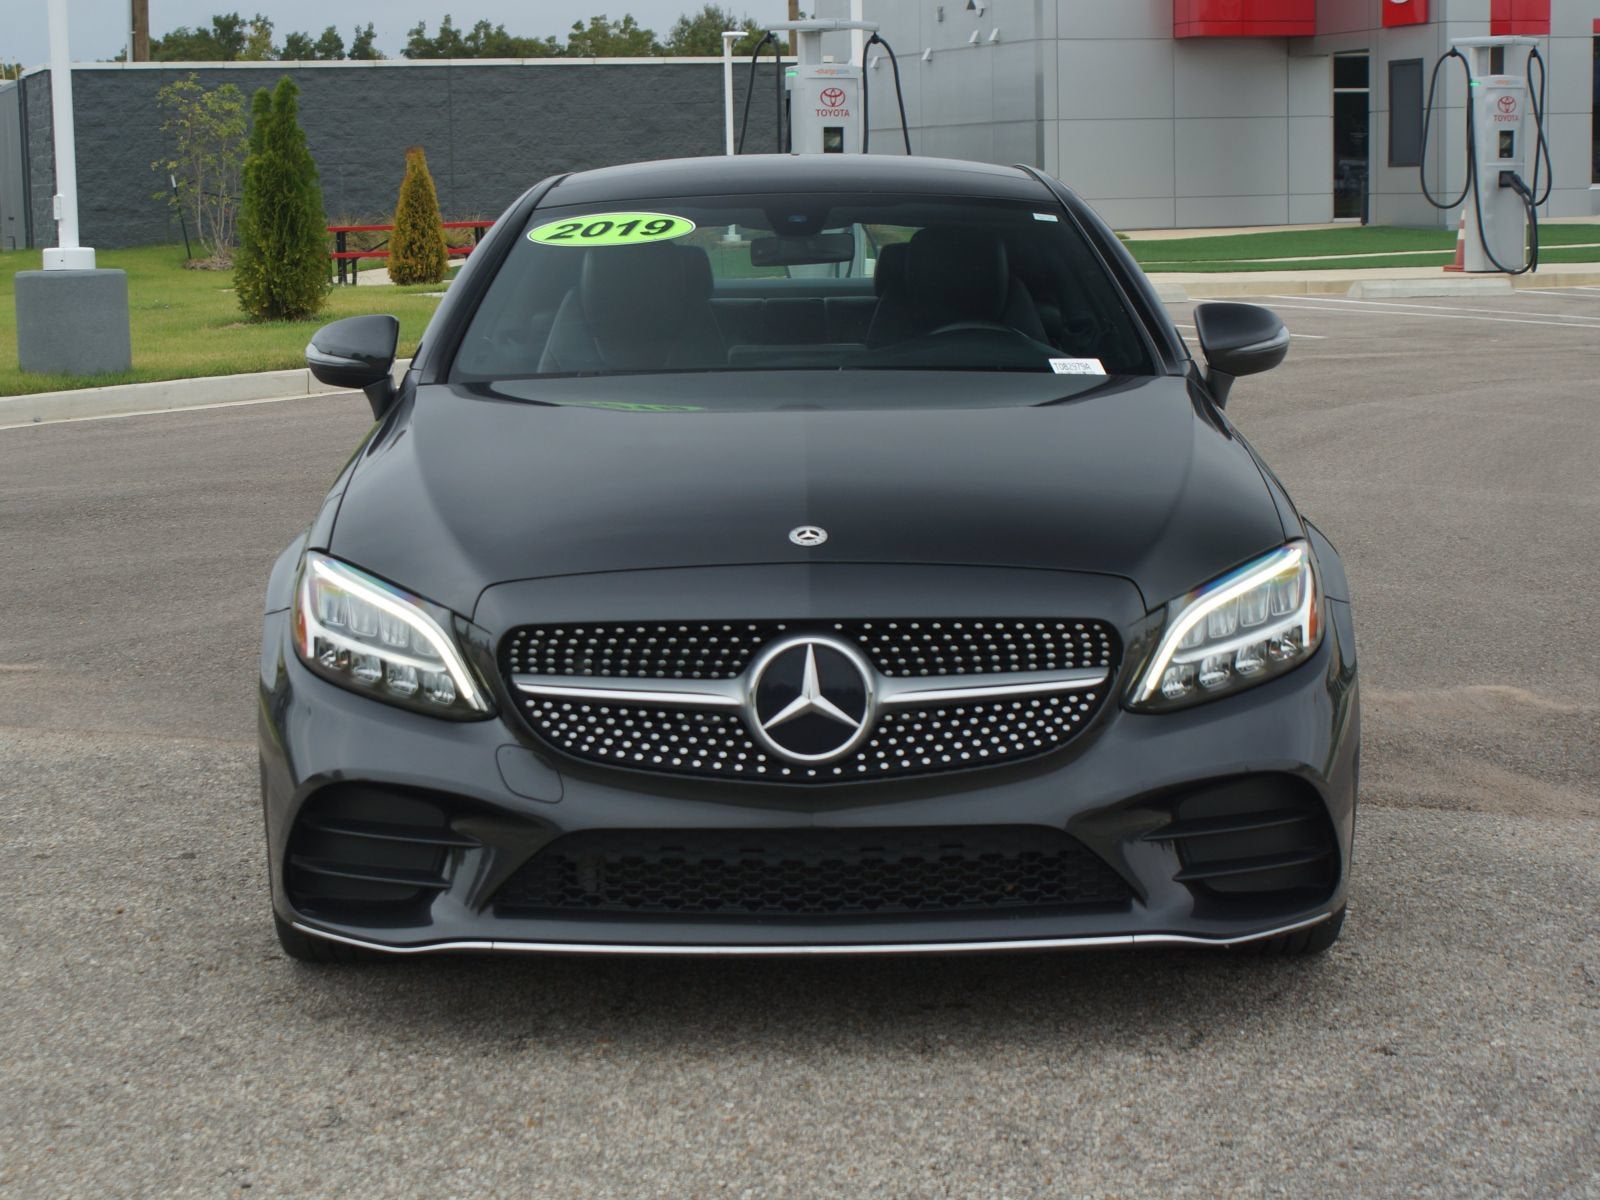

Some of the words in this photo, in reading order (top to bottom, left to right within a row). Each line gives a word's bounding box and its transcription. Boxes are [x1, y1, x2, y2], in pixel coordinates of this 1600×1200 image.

[815, 109, 850, 117] TOYOTA
[1493, 114, 1520, 122] TOYOTA
[543, 219, 676, 241] 2019
